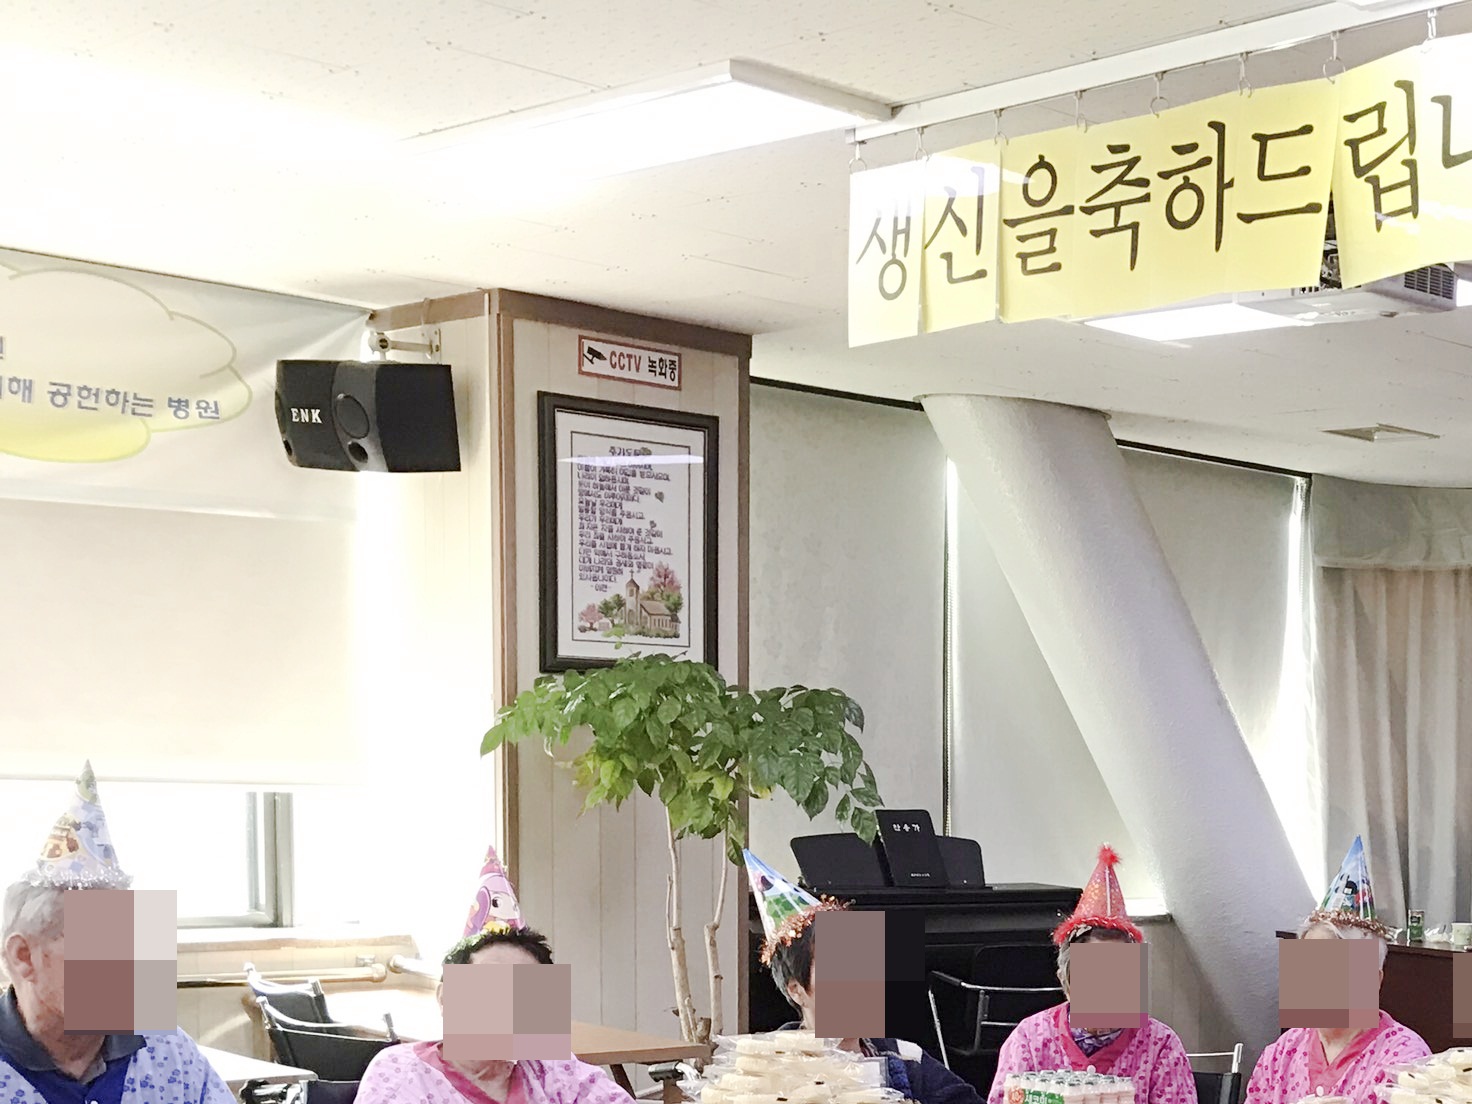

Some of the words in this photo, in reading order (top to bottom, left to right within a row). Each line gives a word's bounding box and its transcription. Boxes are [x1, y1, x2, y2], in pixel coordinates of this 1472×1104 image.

[609, 350, 642, 373] CCTV
[648, 356, 677, 382] 녹화중
[47, 381, 154, 418] 공헌하는
[168, 396, 221, 420] 병원
[291, 408, 322, 424] ENK
